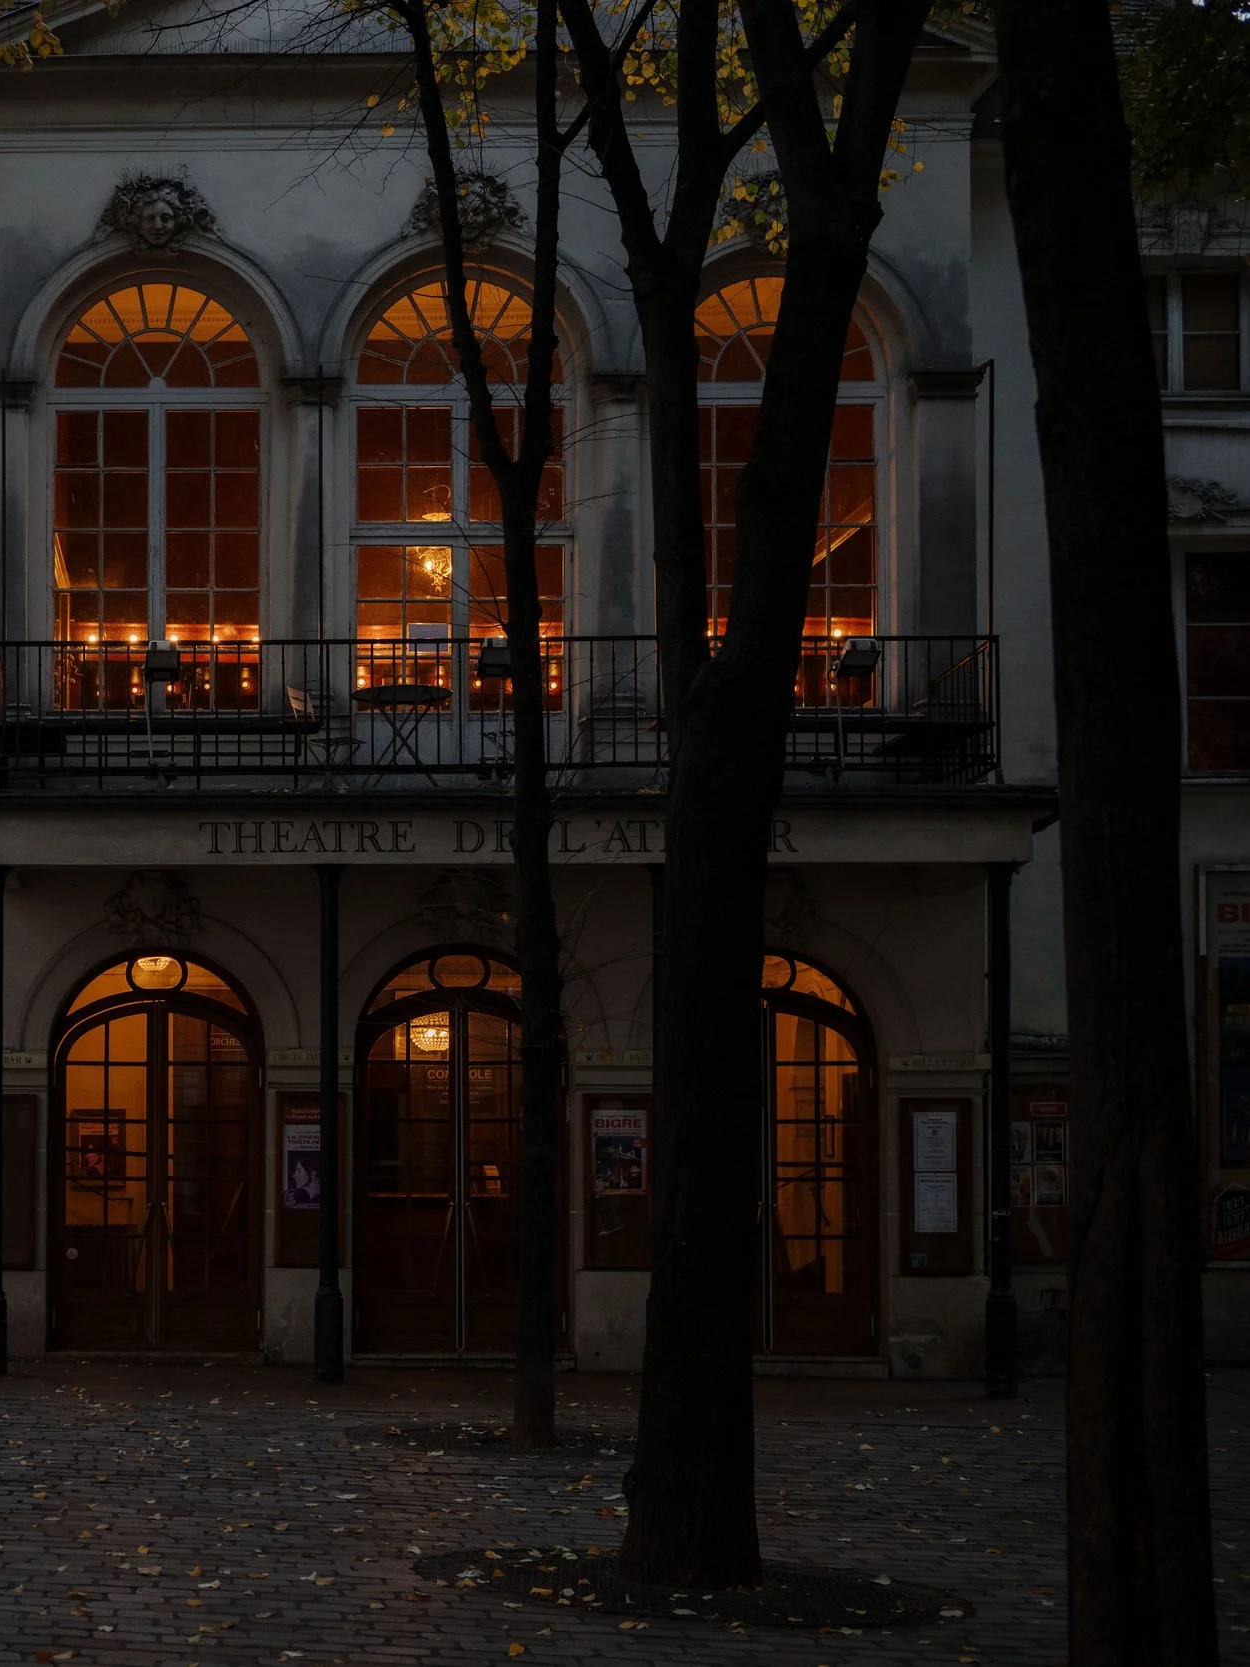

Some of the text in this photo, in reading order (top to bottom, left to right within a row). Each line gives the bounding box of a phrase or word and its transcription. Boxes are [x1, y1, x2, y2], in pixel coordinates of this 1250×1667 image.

[198, 820, 415, 854] THEATRE
[210, 1037, 242, 1046] ORCHES
[595, 1119, 642, 1128] BIGRE
